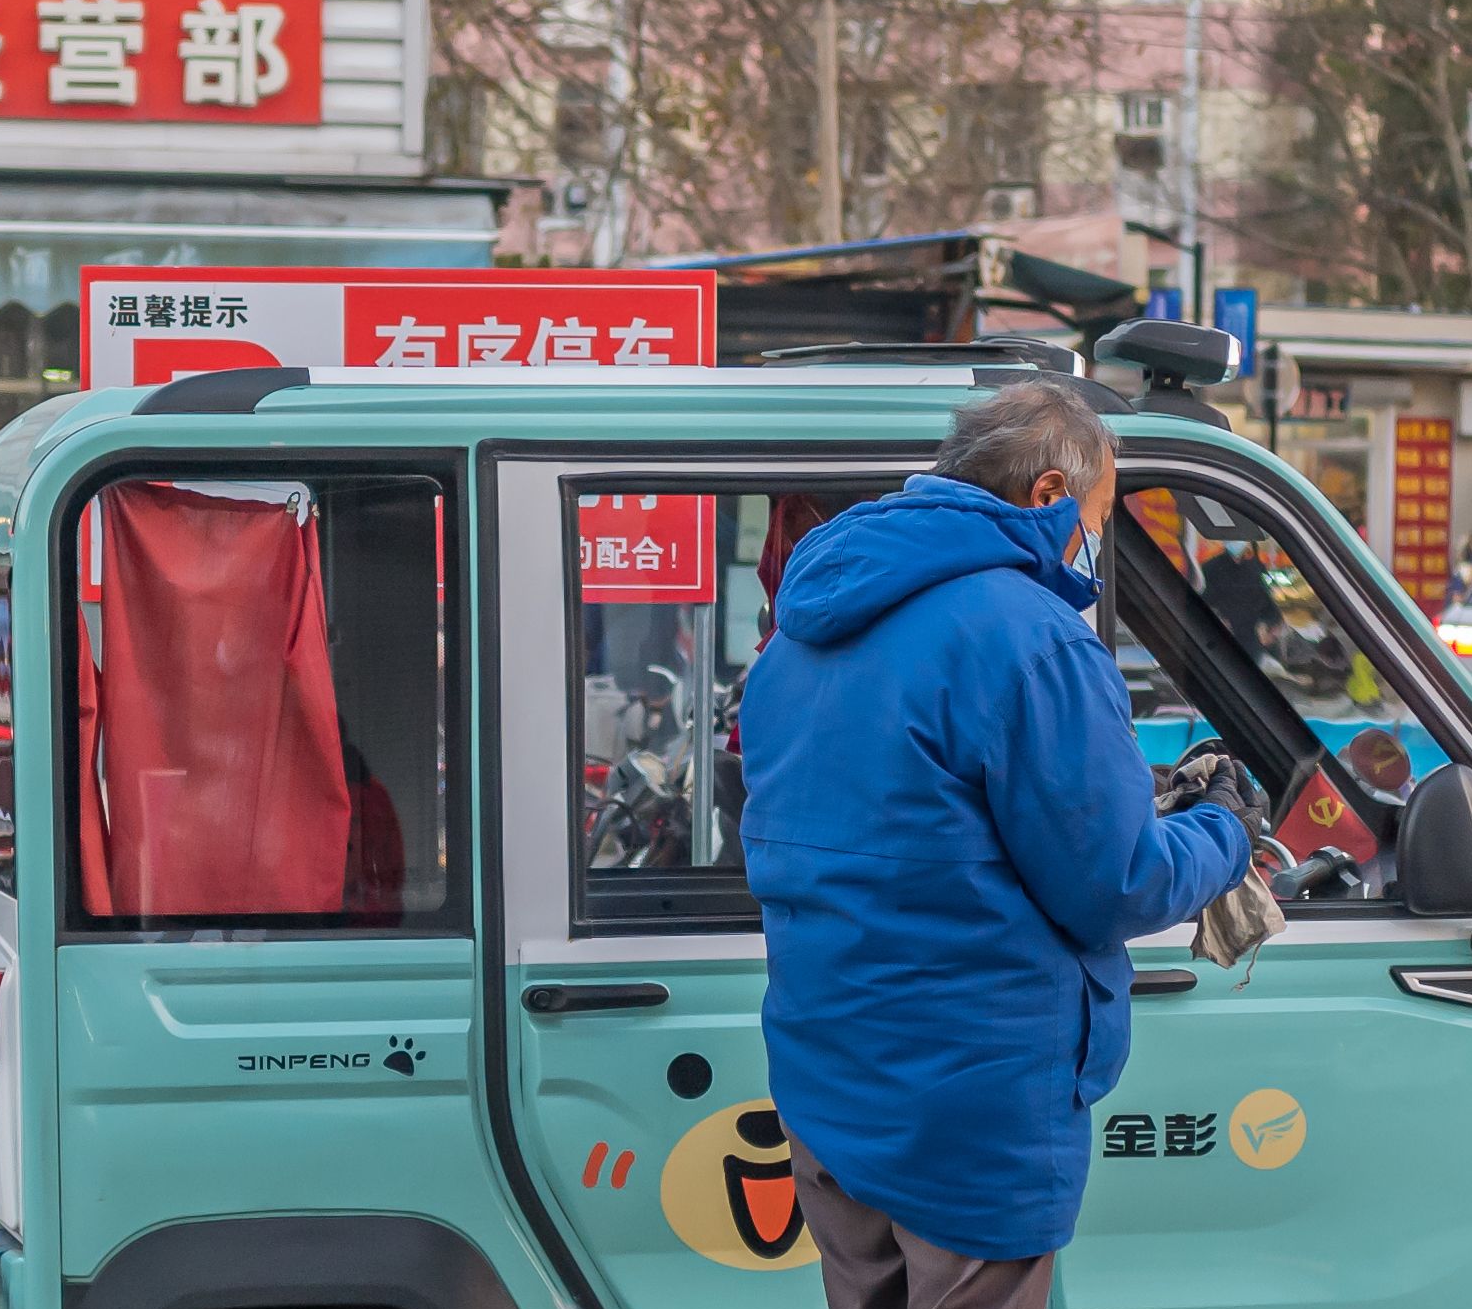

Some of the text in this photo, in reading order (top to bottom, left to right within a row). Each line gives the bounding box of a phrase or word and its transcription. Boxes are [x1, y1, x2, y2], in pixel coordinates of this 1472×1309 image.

[108, 294, 248, 328] 温馨提示
[237, 1052, 371, 1071] JINPENG
[1102, 1112, 1218, 1158] 金彭
